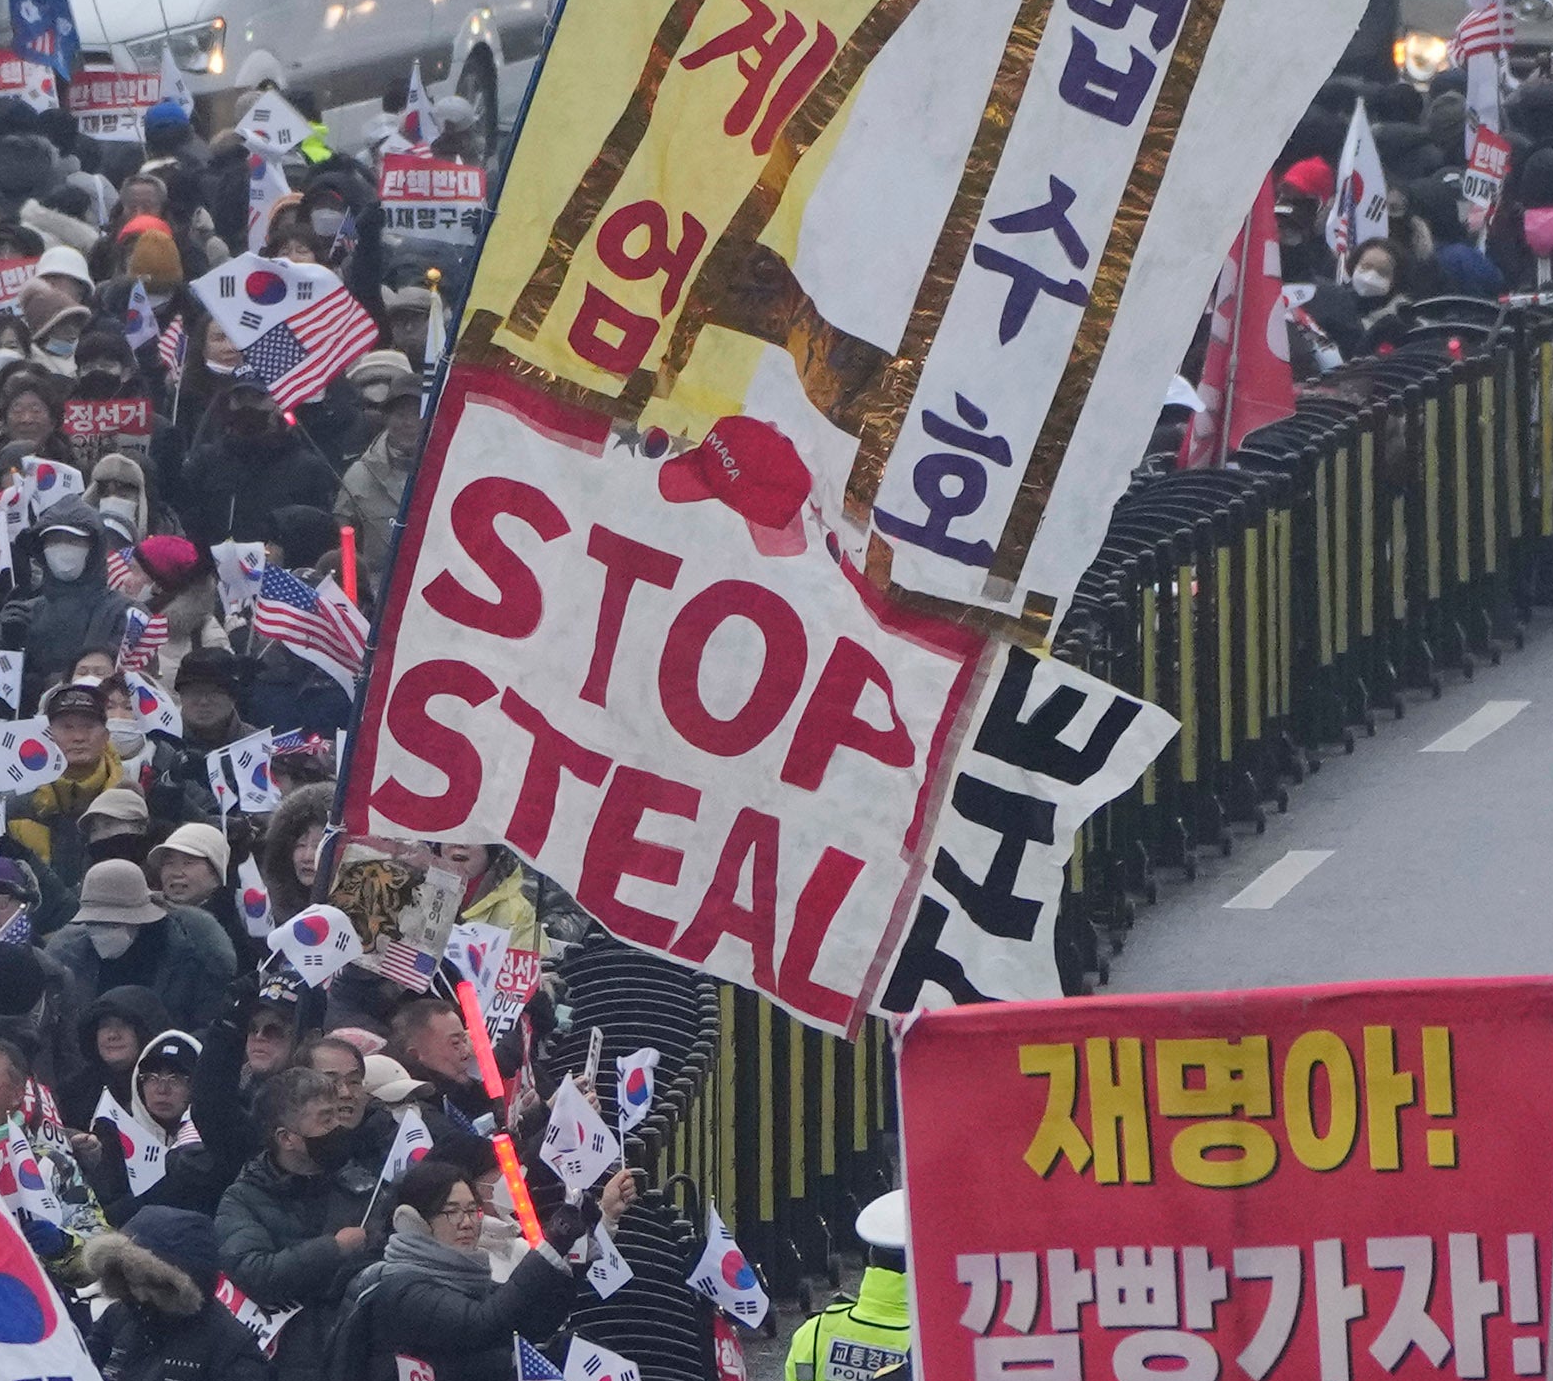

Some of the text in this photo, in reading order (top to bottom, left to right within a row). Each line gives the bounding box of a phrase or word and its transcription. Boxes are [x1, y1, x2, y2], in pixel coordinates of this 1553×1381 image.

[382, 168, 482, 199] 탄핵반대
[67, 403, 148, 432] 정선거
[706, 431, 741, 482] MAGA
[421, 475, 917, 793] STOP
[370, 659, 867, 1024] STEAL
[879, 646, 1143, 1013] THE
[1018, 1025, 1461, 1187] 재명아!
